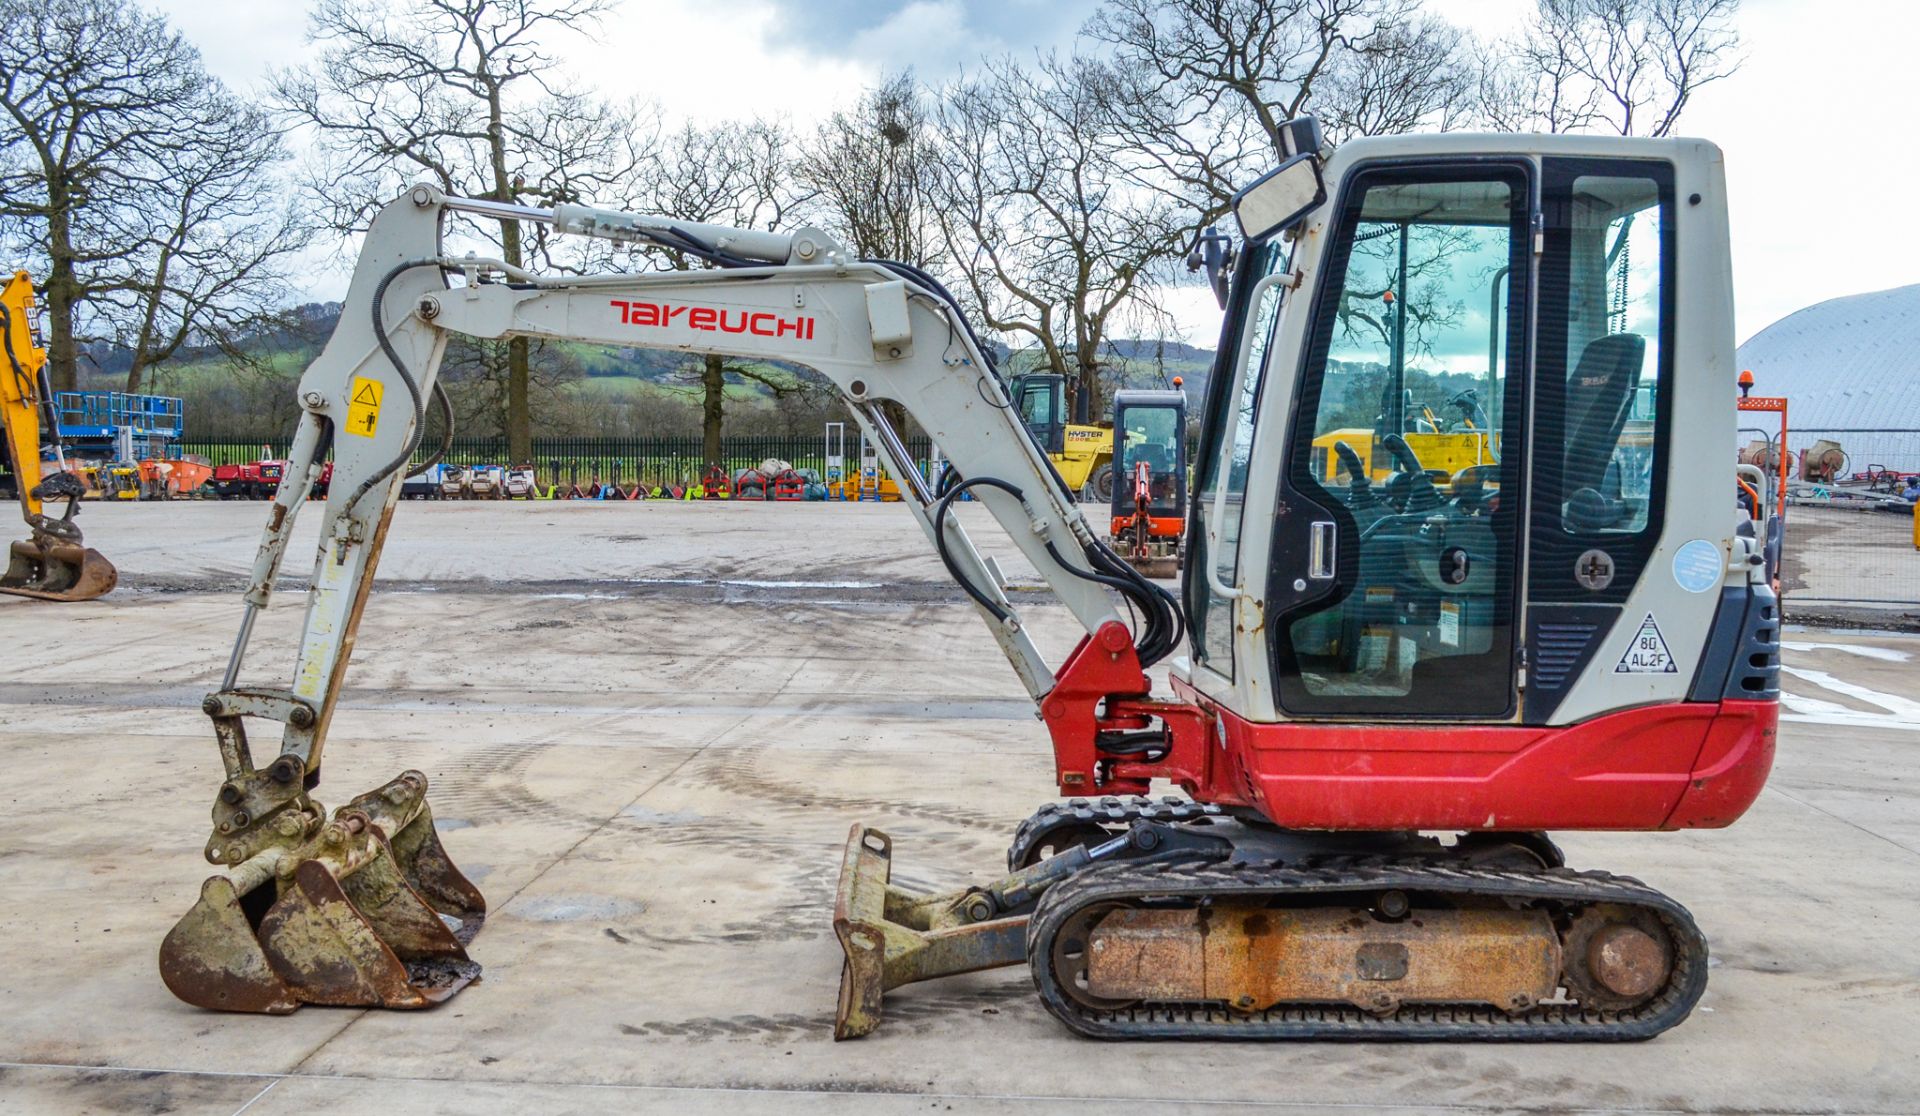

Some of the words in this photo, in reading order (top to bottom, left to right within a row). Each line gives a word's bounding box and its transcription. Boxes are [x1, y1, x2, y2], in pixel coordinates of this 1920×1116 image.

[26, 307, 39, 330] 85
[610, 300, 814, 340] TAKEUCHI
[1631, 653, 1666, 667] AL2F
